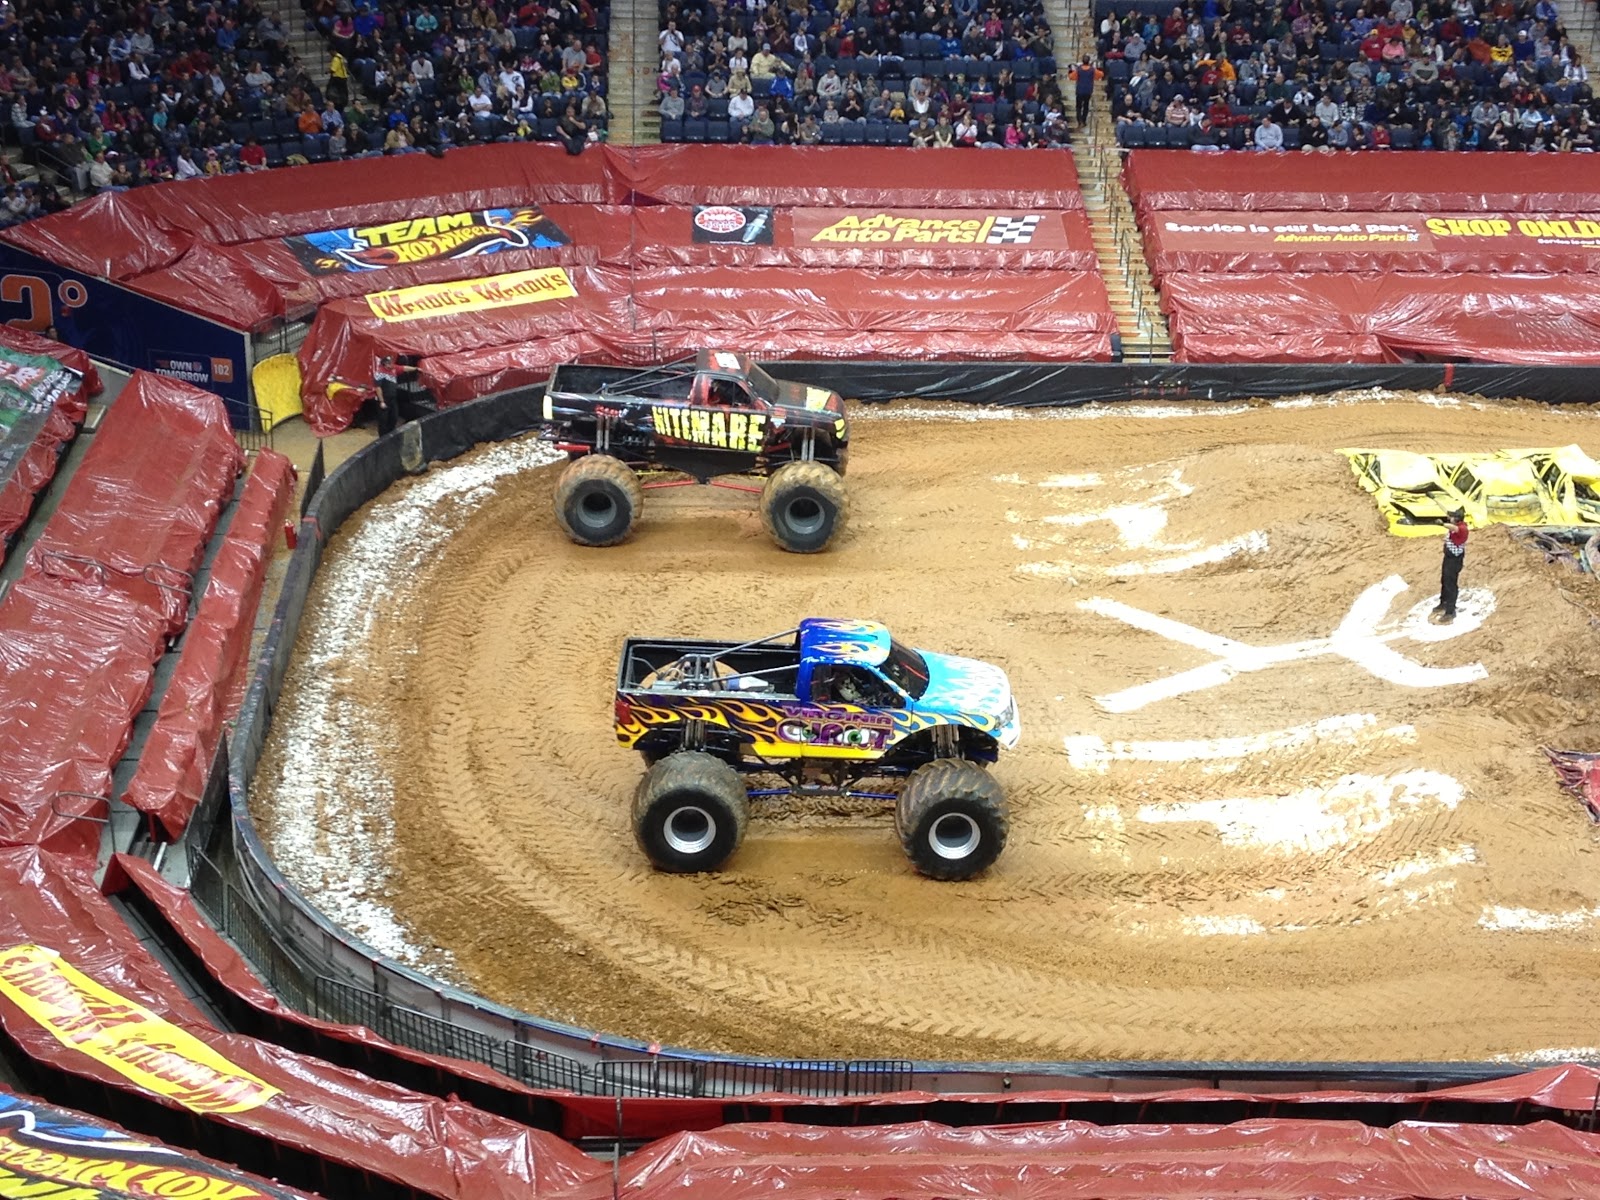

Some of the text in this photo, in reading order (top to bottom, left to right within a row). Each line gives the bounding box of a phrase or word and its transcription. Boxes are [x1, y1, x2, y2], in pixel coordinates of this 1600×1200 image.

[357, 212, 474, 246] TEAM
[833, 214, 982, 230] Advance
[1165, 222, 1246, 233] Service
[1250, 223, 1270, 233] is
[1273, 224, 1308, 232] our
[1313, 223, 1361, 233] best
[1426, 218, 1512, 237] SHOP
[811, 227, 977, 243] Auto Parts
[1274, 234, 1406, 242] Advance Auto Parts
[388, 238, 439, 263] HOT
[170, 360, 192, 372] OWN
[214, 364, 230, 376] 102
[652, 405, 766, 452] NITEMARE
[782, 705, 893, 725] VIRGINIA
